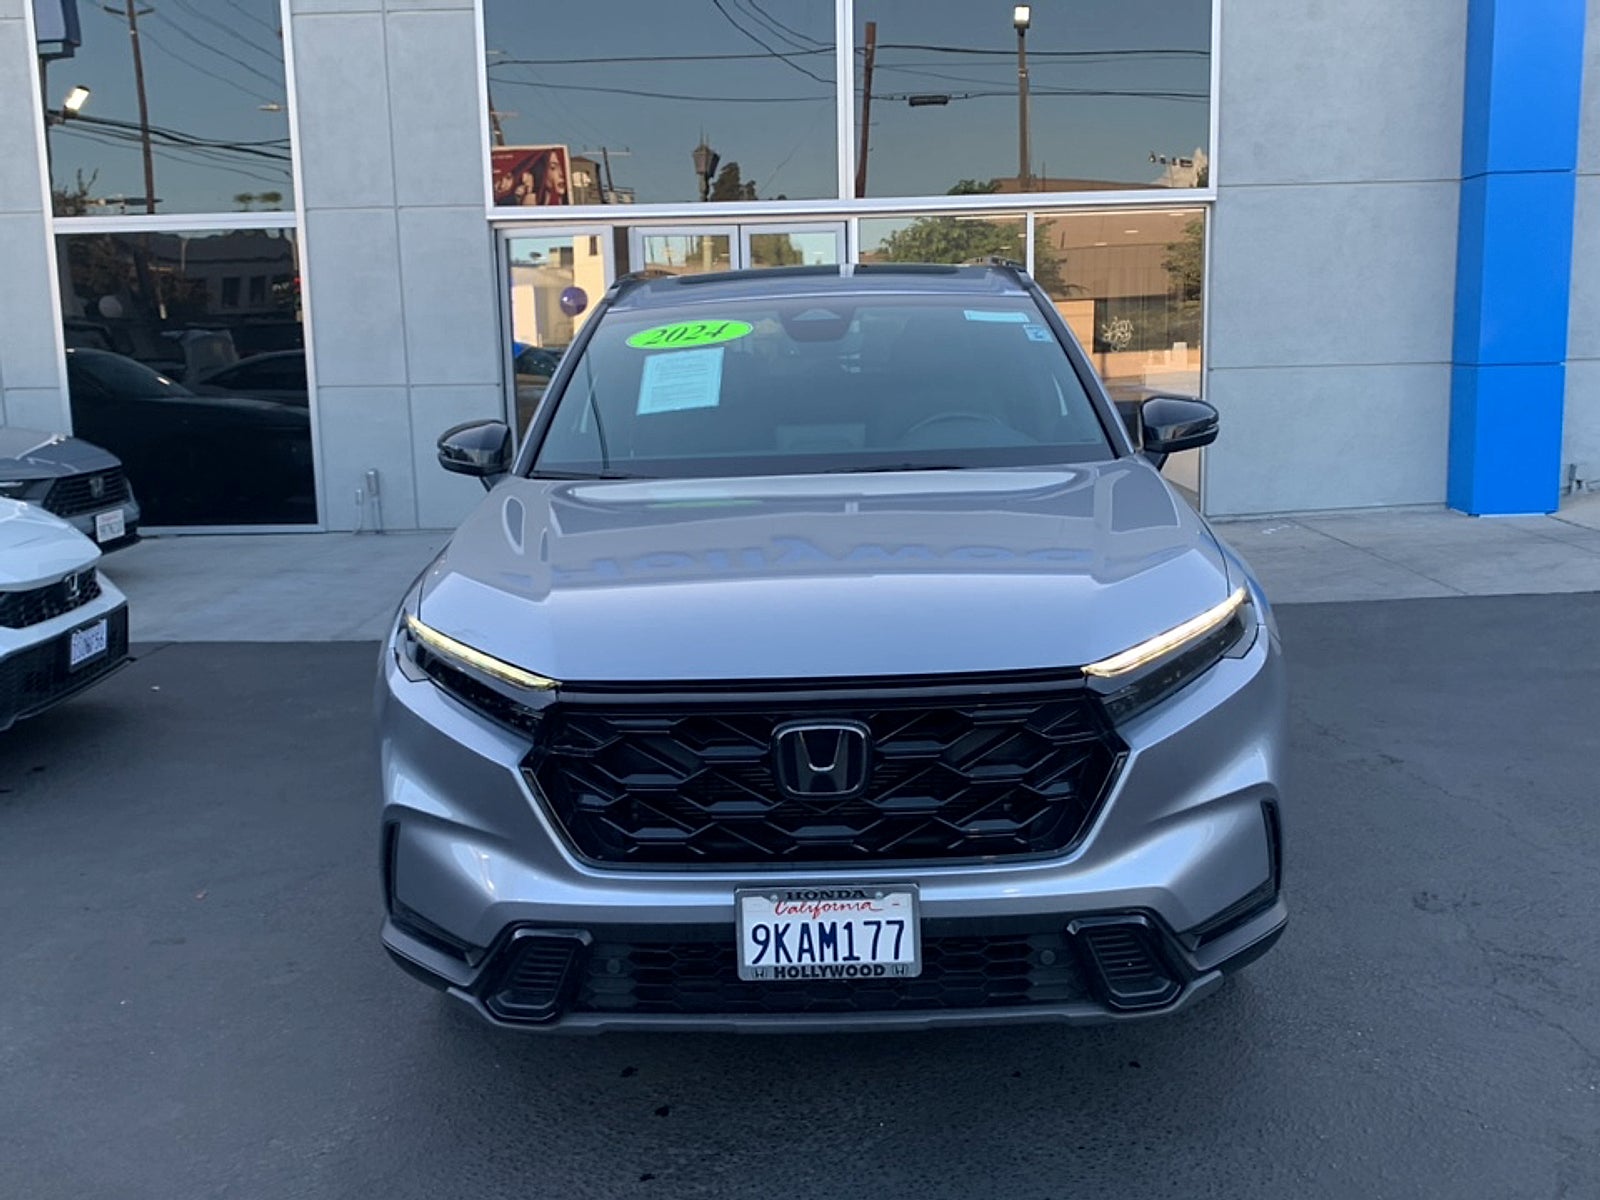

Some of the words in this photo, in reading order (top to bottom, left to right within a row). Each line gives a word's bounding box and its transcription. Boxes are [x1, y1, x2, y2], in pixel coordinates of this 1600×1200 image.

[643, 322, 730, 346] 2024
[786, 890, 866, 901] HONDA
[774, 900, 883, 918] California
[751, 920, 905, 964] 9KAM177
[774, 964, 885, 978] HOLLYWOOD
